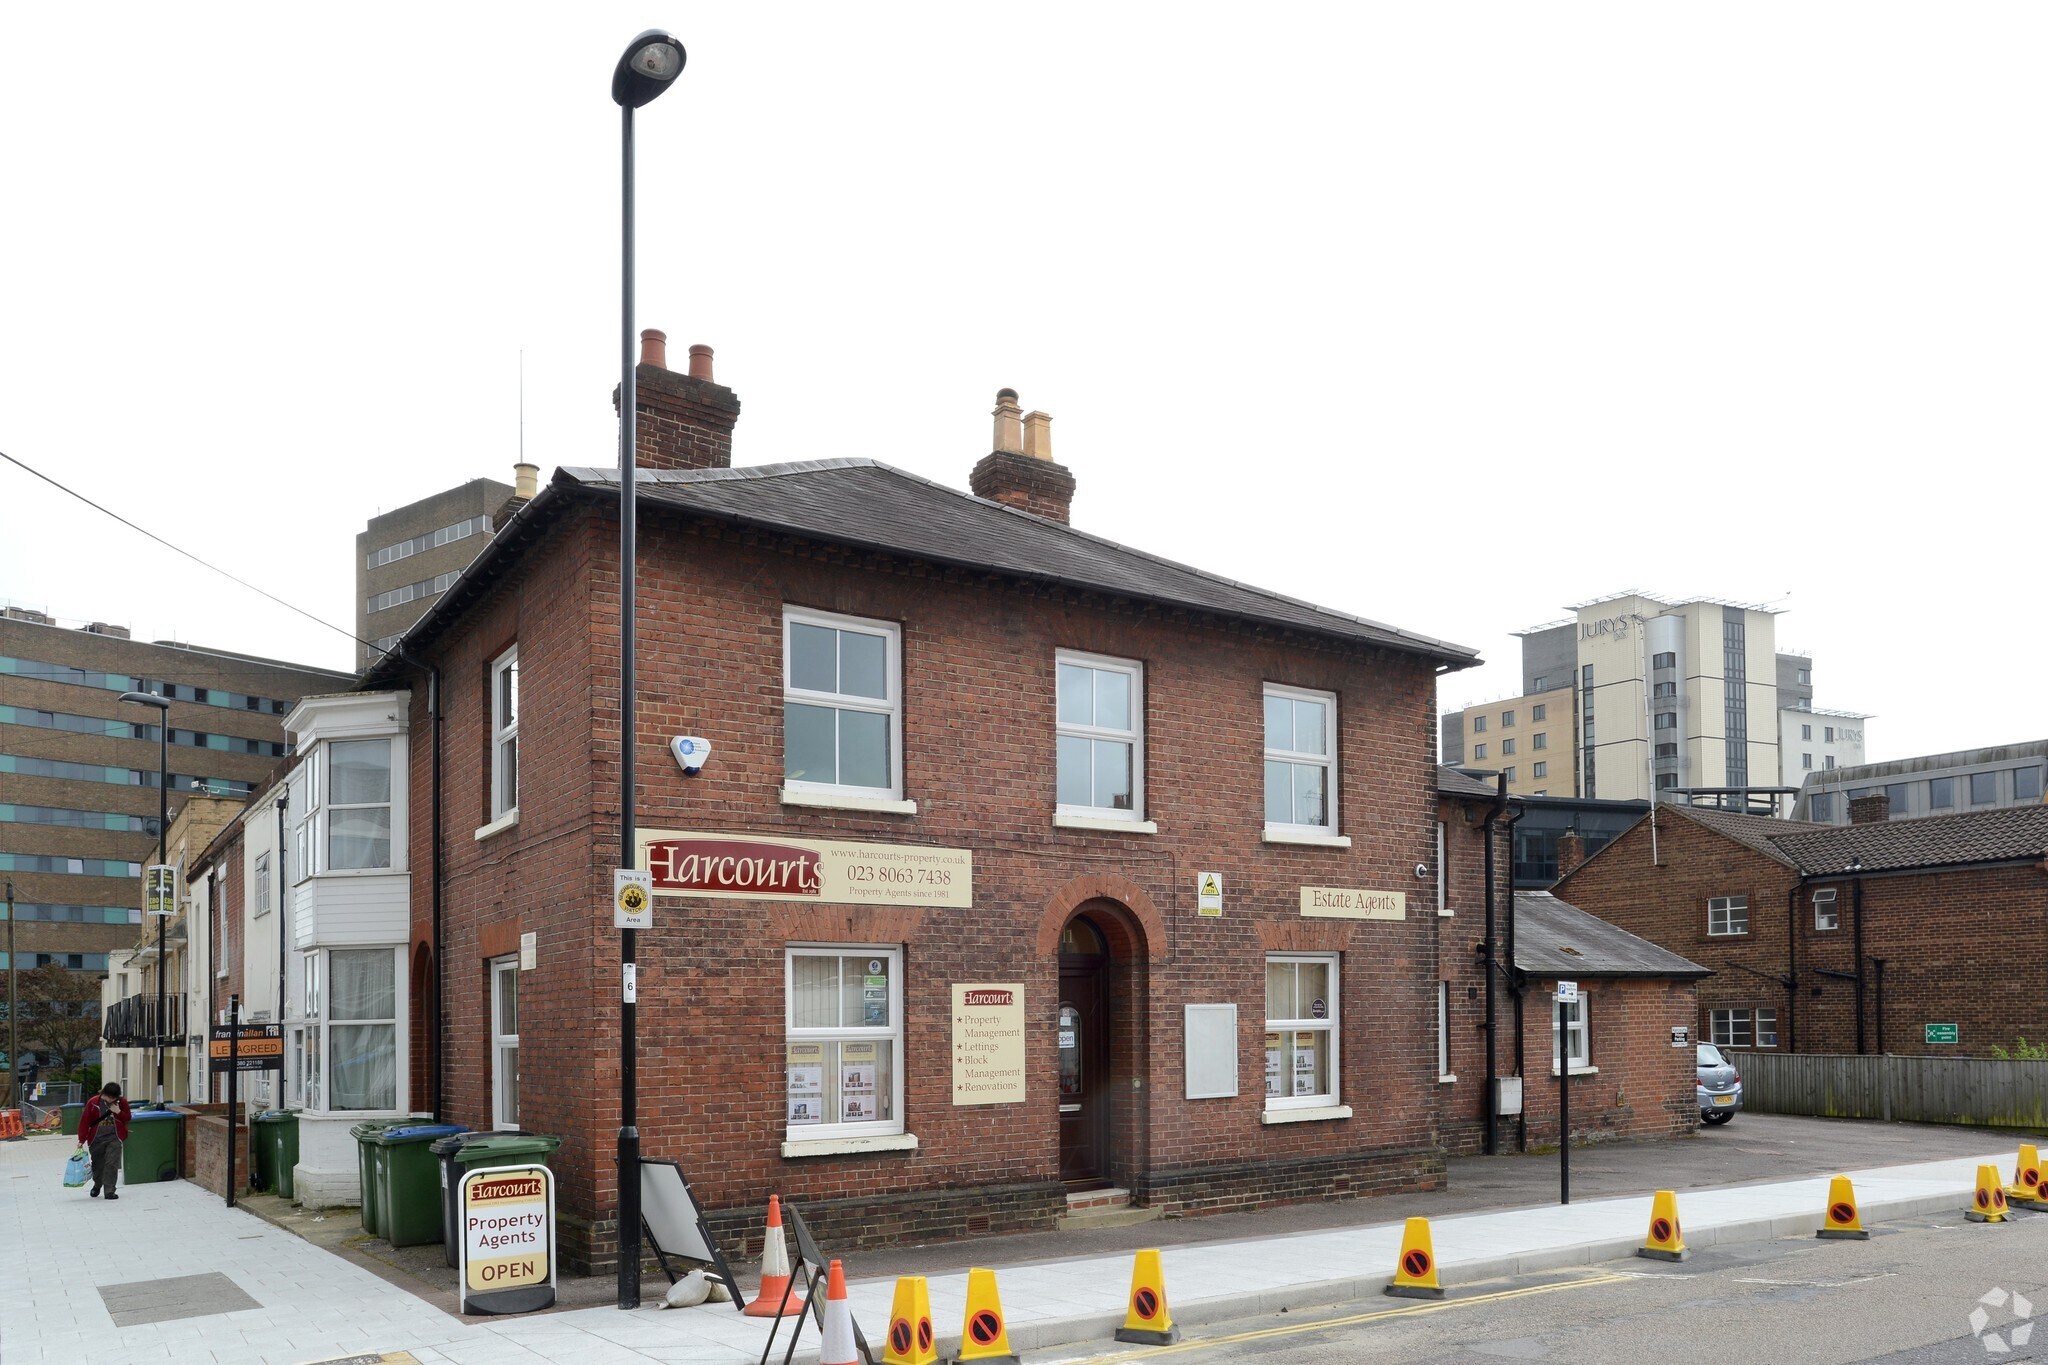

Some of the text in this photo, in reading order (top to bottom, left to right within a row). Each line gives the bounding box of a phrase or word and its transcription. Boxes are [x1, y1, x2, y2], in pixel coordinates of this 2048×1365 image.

[1579, 615, 1627, 641] JURYS
[1835, 727, 1862, 742] JURYS
[831, 849, 966, 865] www.harcourts-property.co.uk
[640, 845, 826, 889] Harcourts
[847, 865, 951, 885] 023 8063 7438
[849, 887, 949, 899] Property Agents since 1981
[1313, 890, 1396, 916] Estate Agents
[627, 982, 633, 991] 6
[964, 992, 1013, 1004] Harcourts
[964, 1015, 1001, 1027] Property
[965, 1029, 1020, 1040] Management
[237, 1043, 277, 1054] AGREED
[964, 1042, 999, 1053] Lettings
[964, 1055, 988, 1065] Block
[965, 1068, 1020, 1080] Management
[965, 1081, 1018, 1091] Renovations
[470, 1181, 542, 1199] Harcourts
[469, 1213, 543, 1231] Property
[479, 1231, 536, 1250] Agents
[481, 1261, 534, 1281] OPEN
